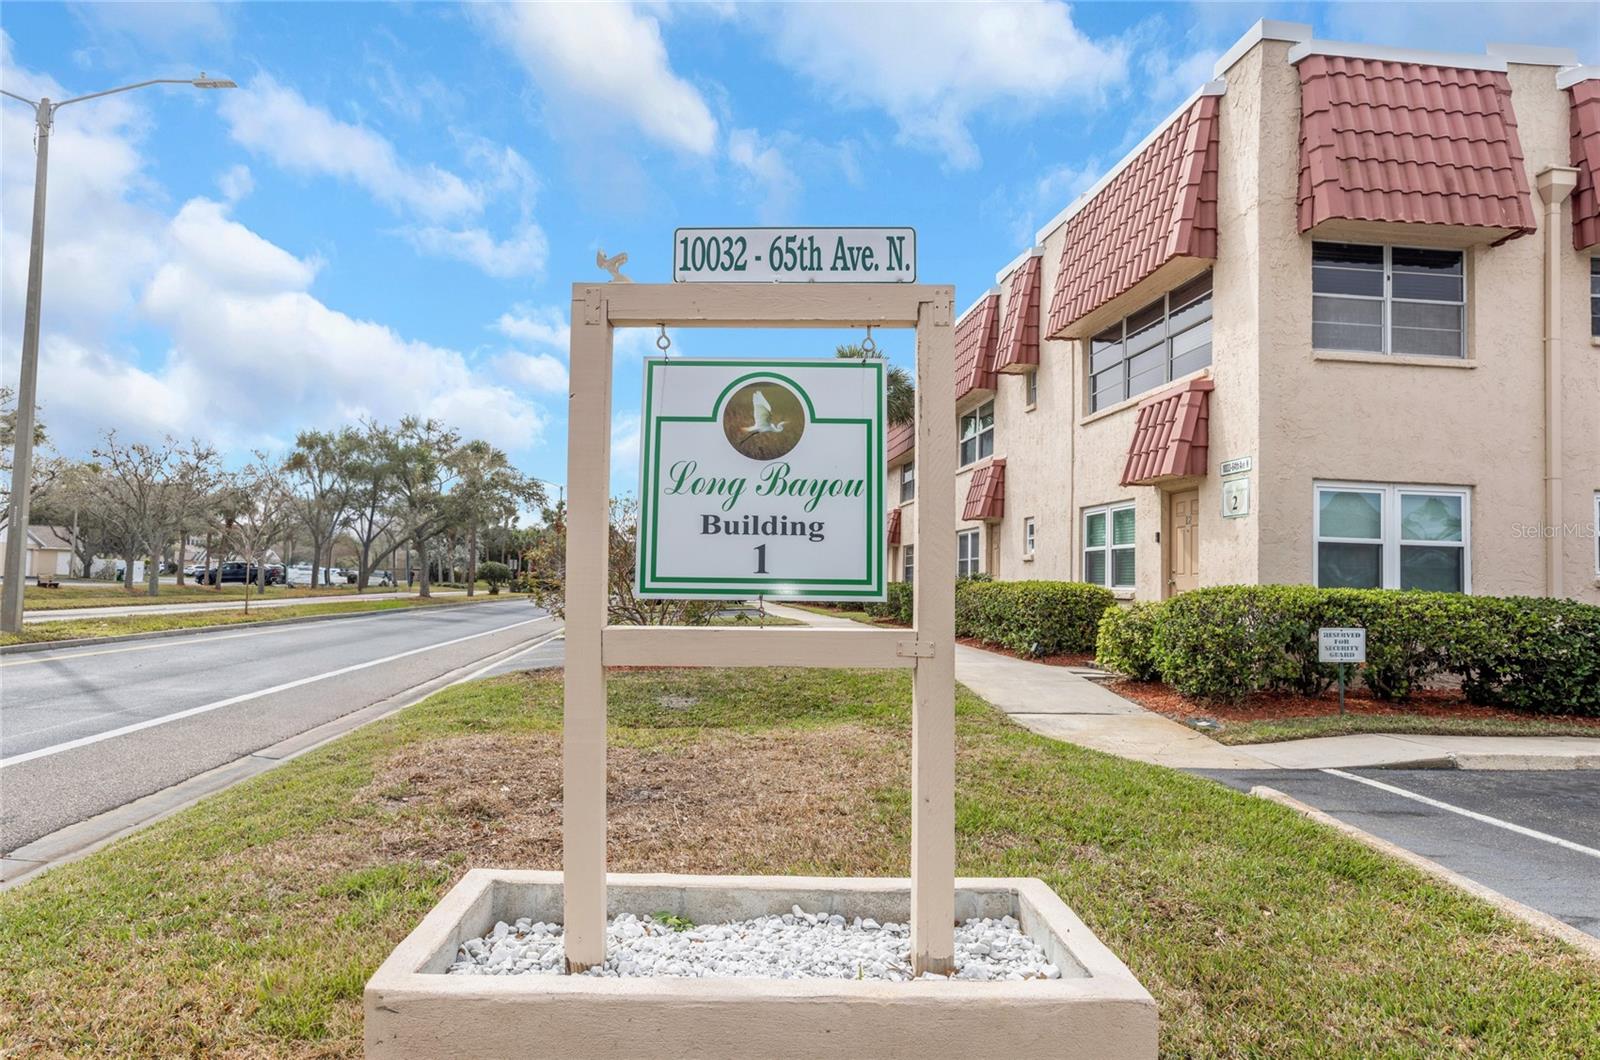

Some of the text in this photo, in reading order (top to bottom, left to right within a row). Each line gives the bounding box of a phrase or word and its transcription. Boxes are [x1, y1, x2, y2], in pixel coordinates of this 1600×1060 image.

[679, 235, 748, 272] 10032
[769, 234, 823, 271] 65th
[830, 235, 880, 272] Ave.
[886, 235, 911, 271] N.
[664, 460, 865, 513] Long Bayou
[1231, 495, 1238, 510] 2
[700, 513, 825, 543] Building
[753, 543, 770, 575] 1
